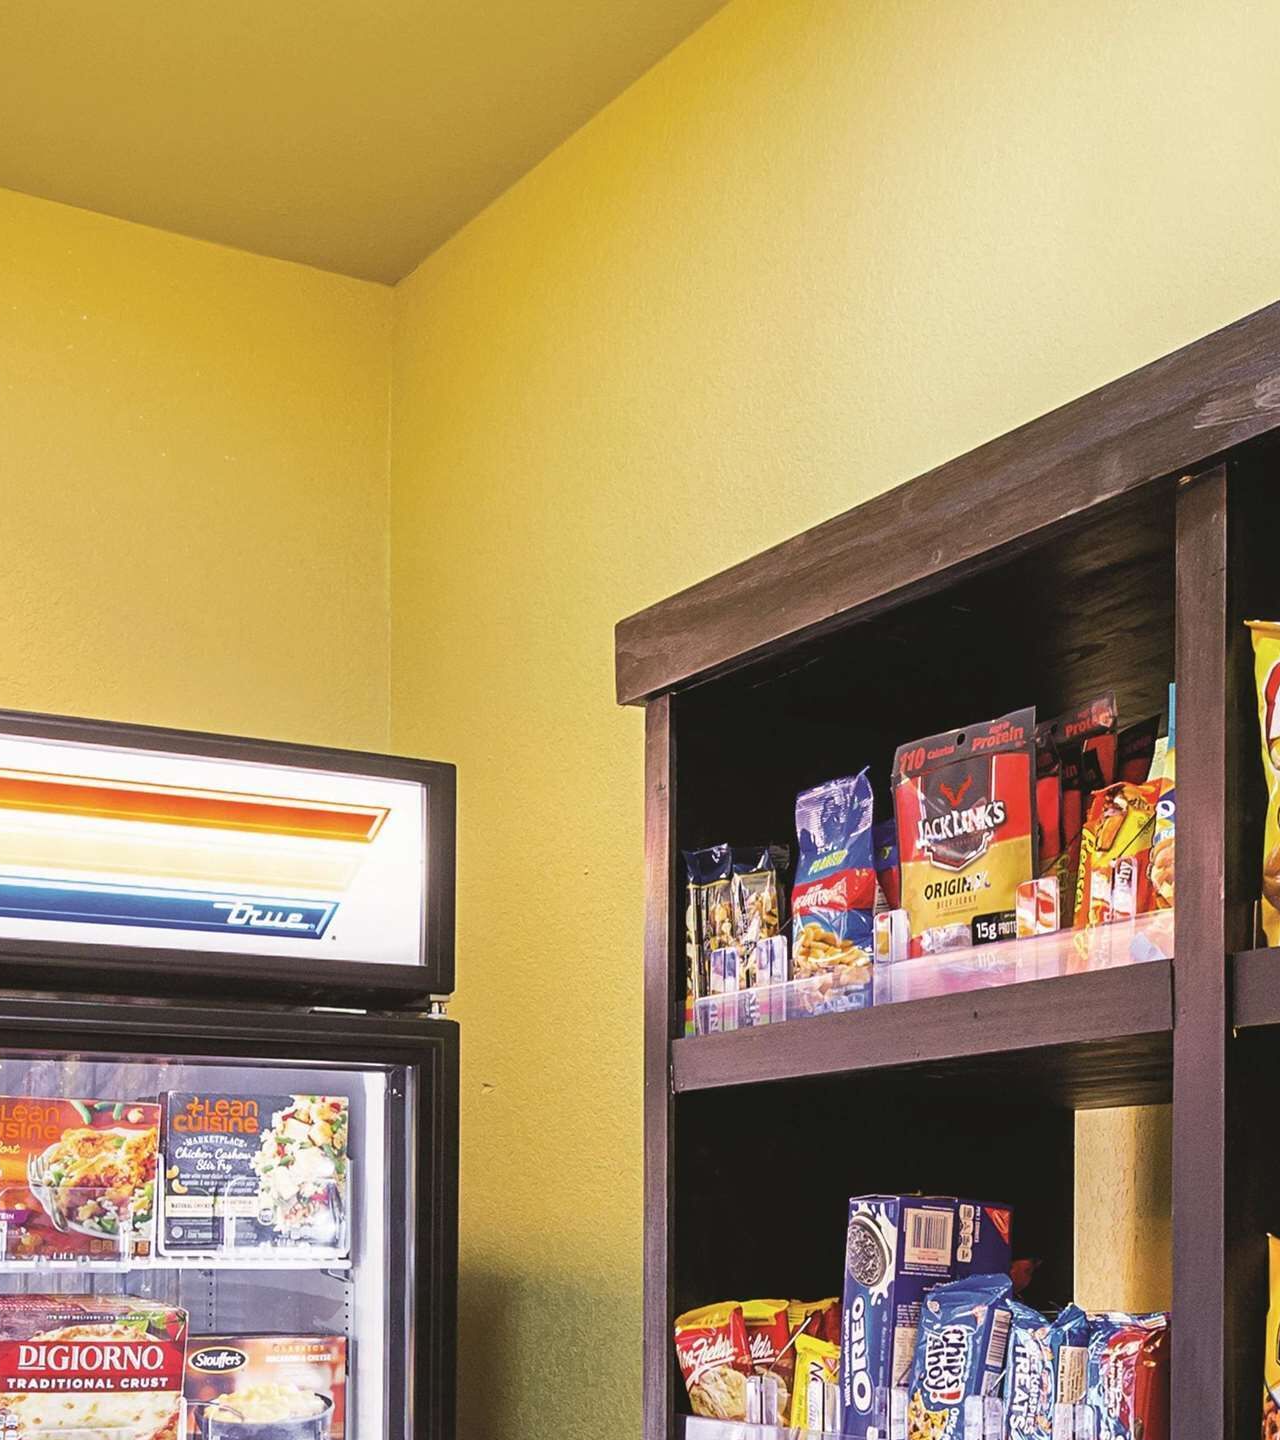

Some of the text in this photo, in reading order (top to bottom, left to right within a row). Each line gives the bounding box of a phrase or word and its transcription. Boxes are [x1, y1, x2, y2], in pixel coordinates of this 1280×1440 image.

[971, 725, 1025, 751] Protein
[898, 746, 927, 774] 110
[975, 922, 998, 940] 15g
[0, 1104, 61, 1122] Lean
[204, 1098, 259, 1117] Lean
[194, 1351, 242, 1371] Stouffer's
[851, 1295, 872, 1417] OREO
[940, 1326, 967, 1390] Chips
[7, 1376, 169, 1389] TRADITIONAL CRUST
[1010, 1343, 1030, 1431] TREATS
